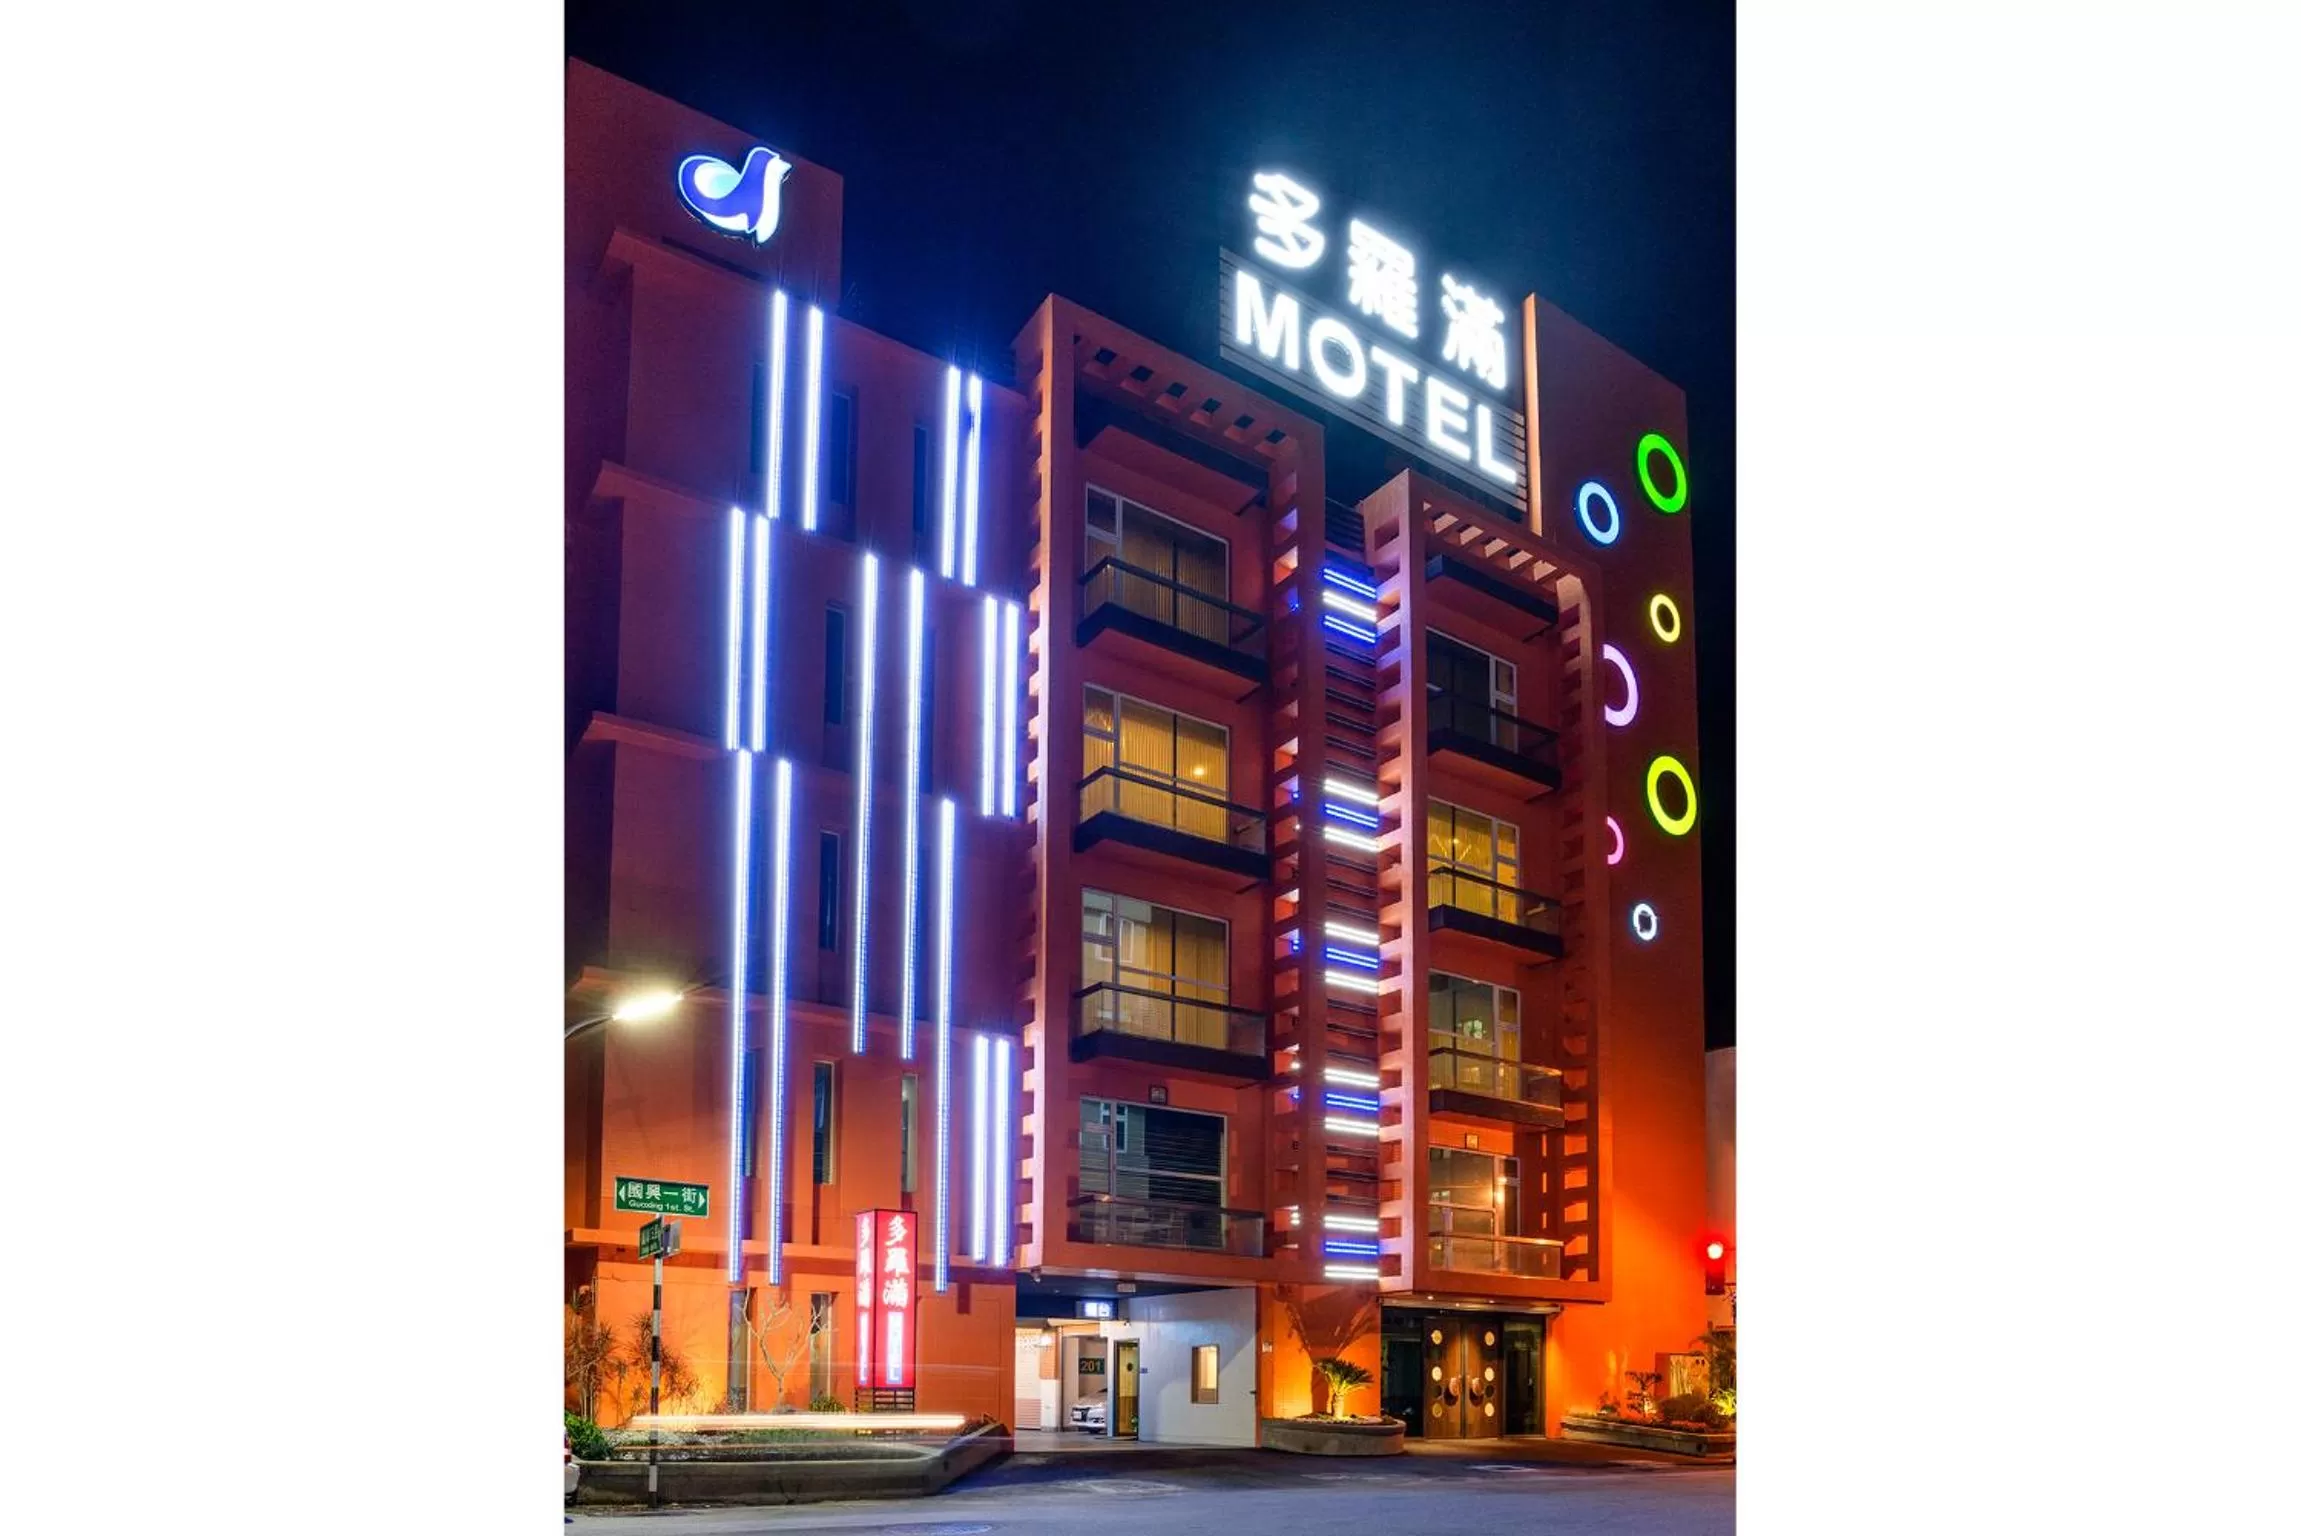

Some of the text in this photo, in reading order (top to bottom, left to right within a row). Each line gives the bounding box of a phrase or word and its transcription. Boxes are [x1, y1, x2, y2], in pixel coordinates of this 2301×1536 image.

[1249, 172, 1507, 389] 多羅滿
[1235, 270, 1517, 484] MOTEL
[627, 1181, 697, 1203] 國興一街
[1080, 1360, 1102, 1373] 201
